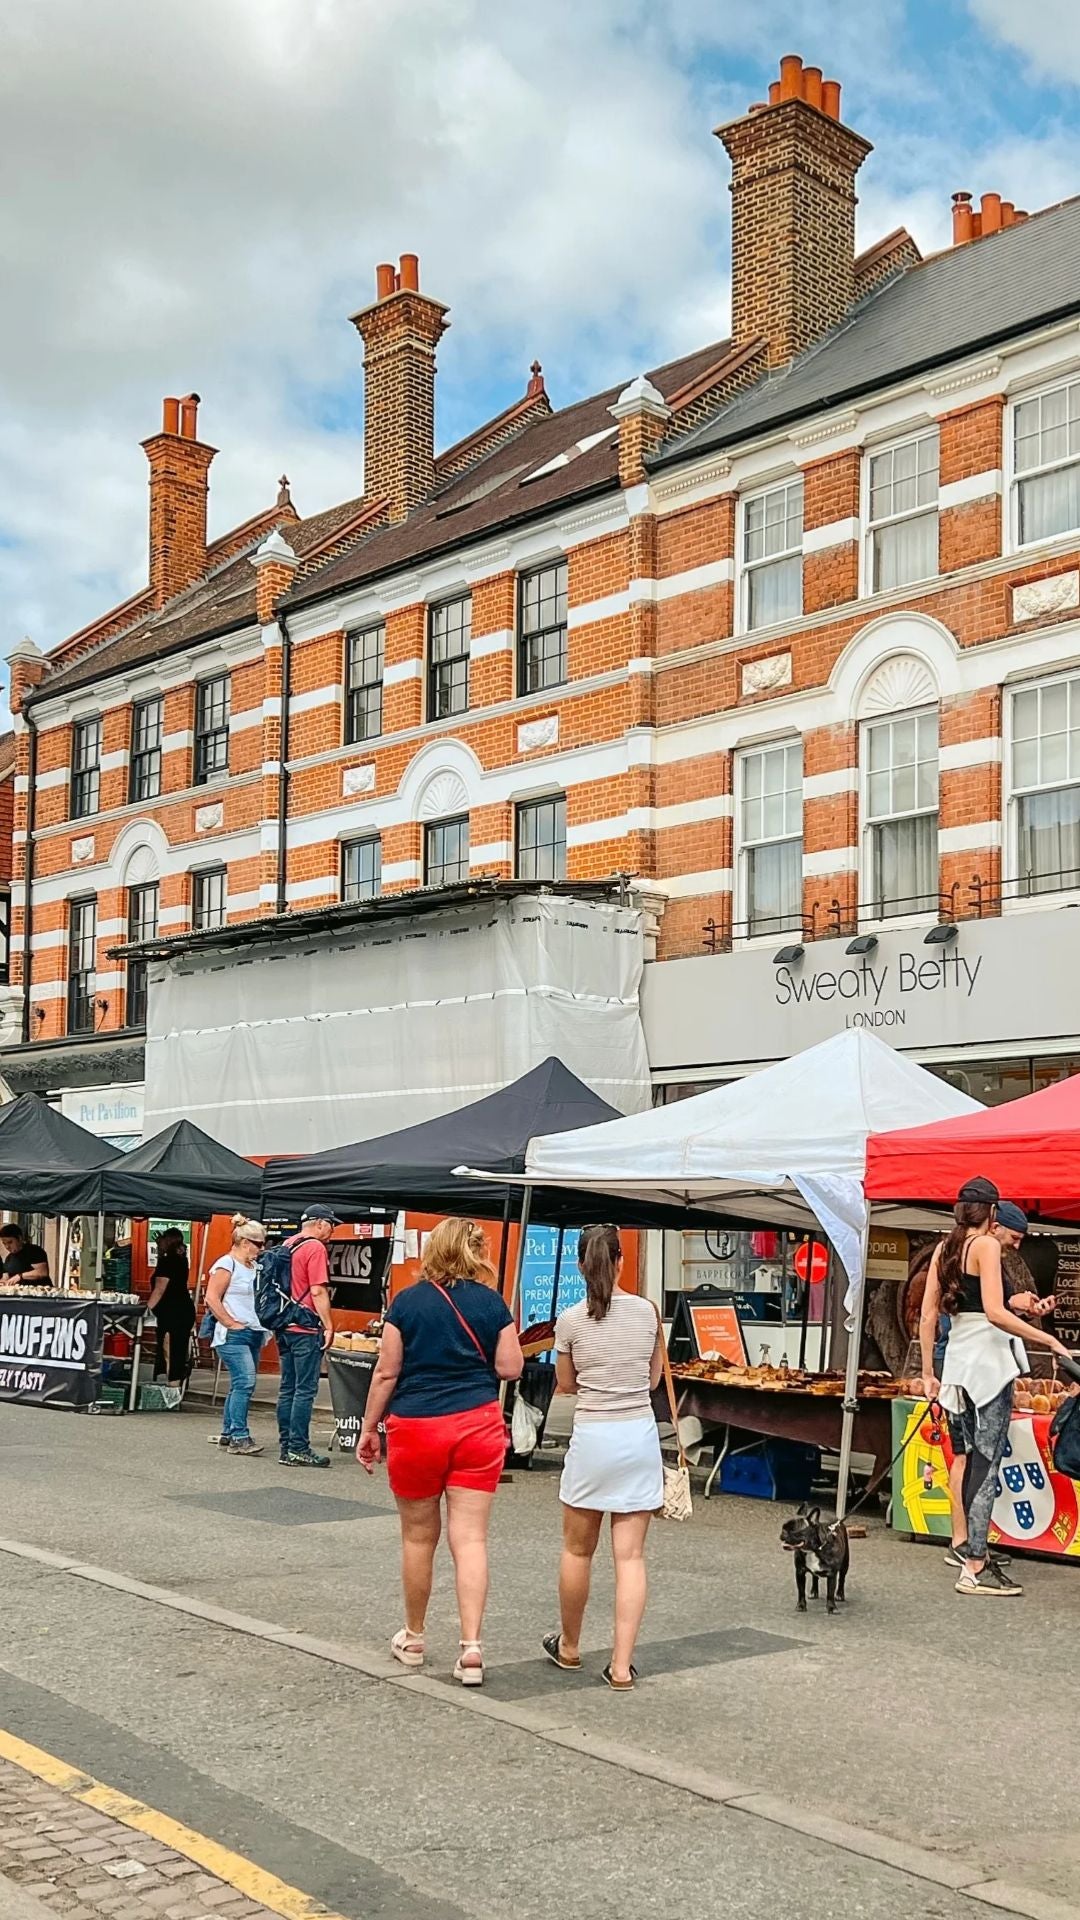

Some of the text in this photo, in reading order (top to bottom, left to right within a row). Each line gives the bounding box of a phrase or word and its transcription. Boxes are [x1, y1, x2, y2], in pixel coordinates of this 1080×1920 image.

[775, 947, 982, 1006] Sweaty Betty
[845, 1009, 905, 1029] LONDON
[80, 1101, 137, 1122] Pet Pavilion
[526, 1238, 546, 1256] Pet
[0, 1313, 88, 1361] MUFFINS
[1054, 1327, 1080, 1342] Try
[14, 1370, 46, 1392] TASTY
